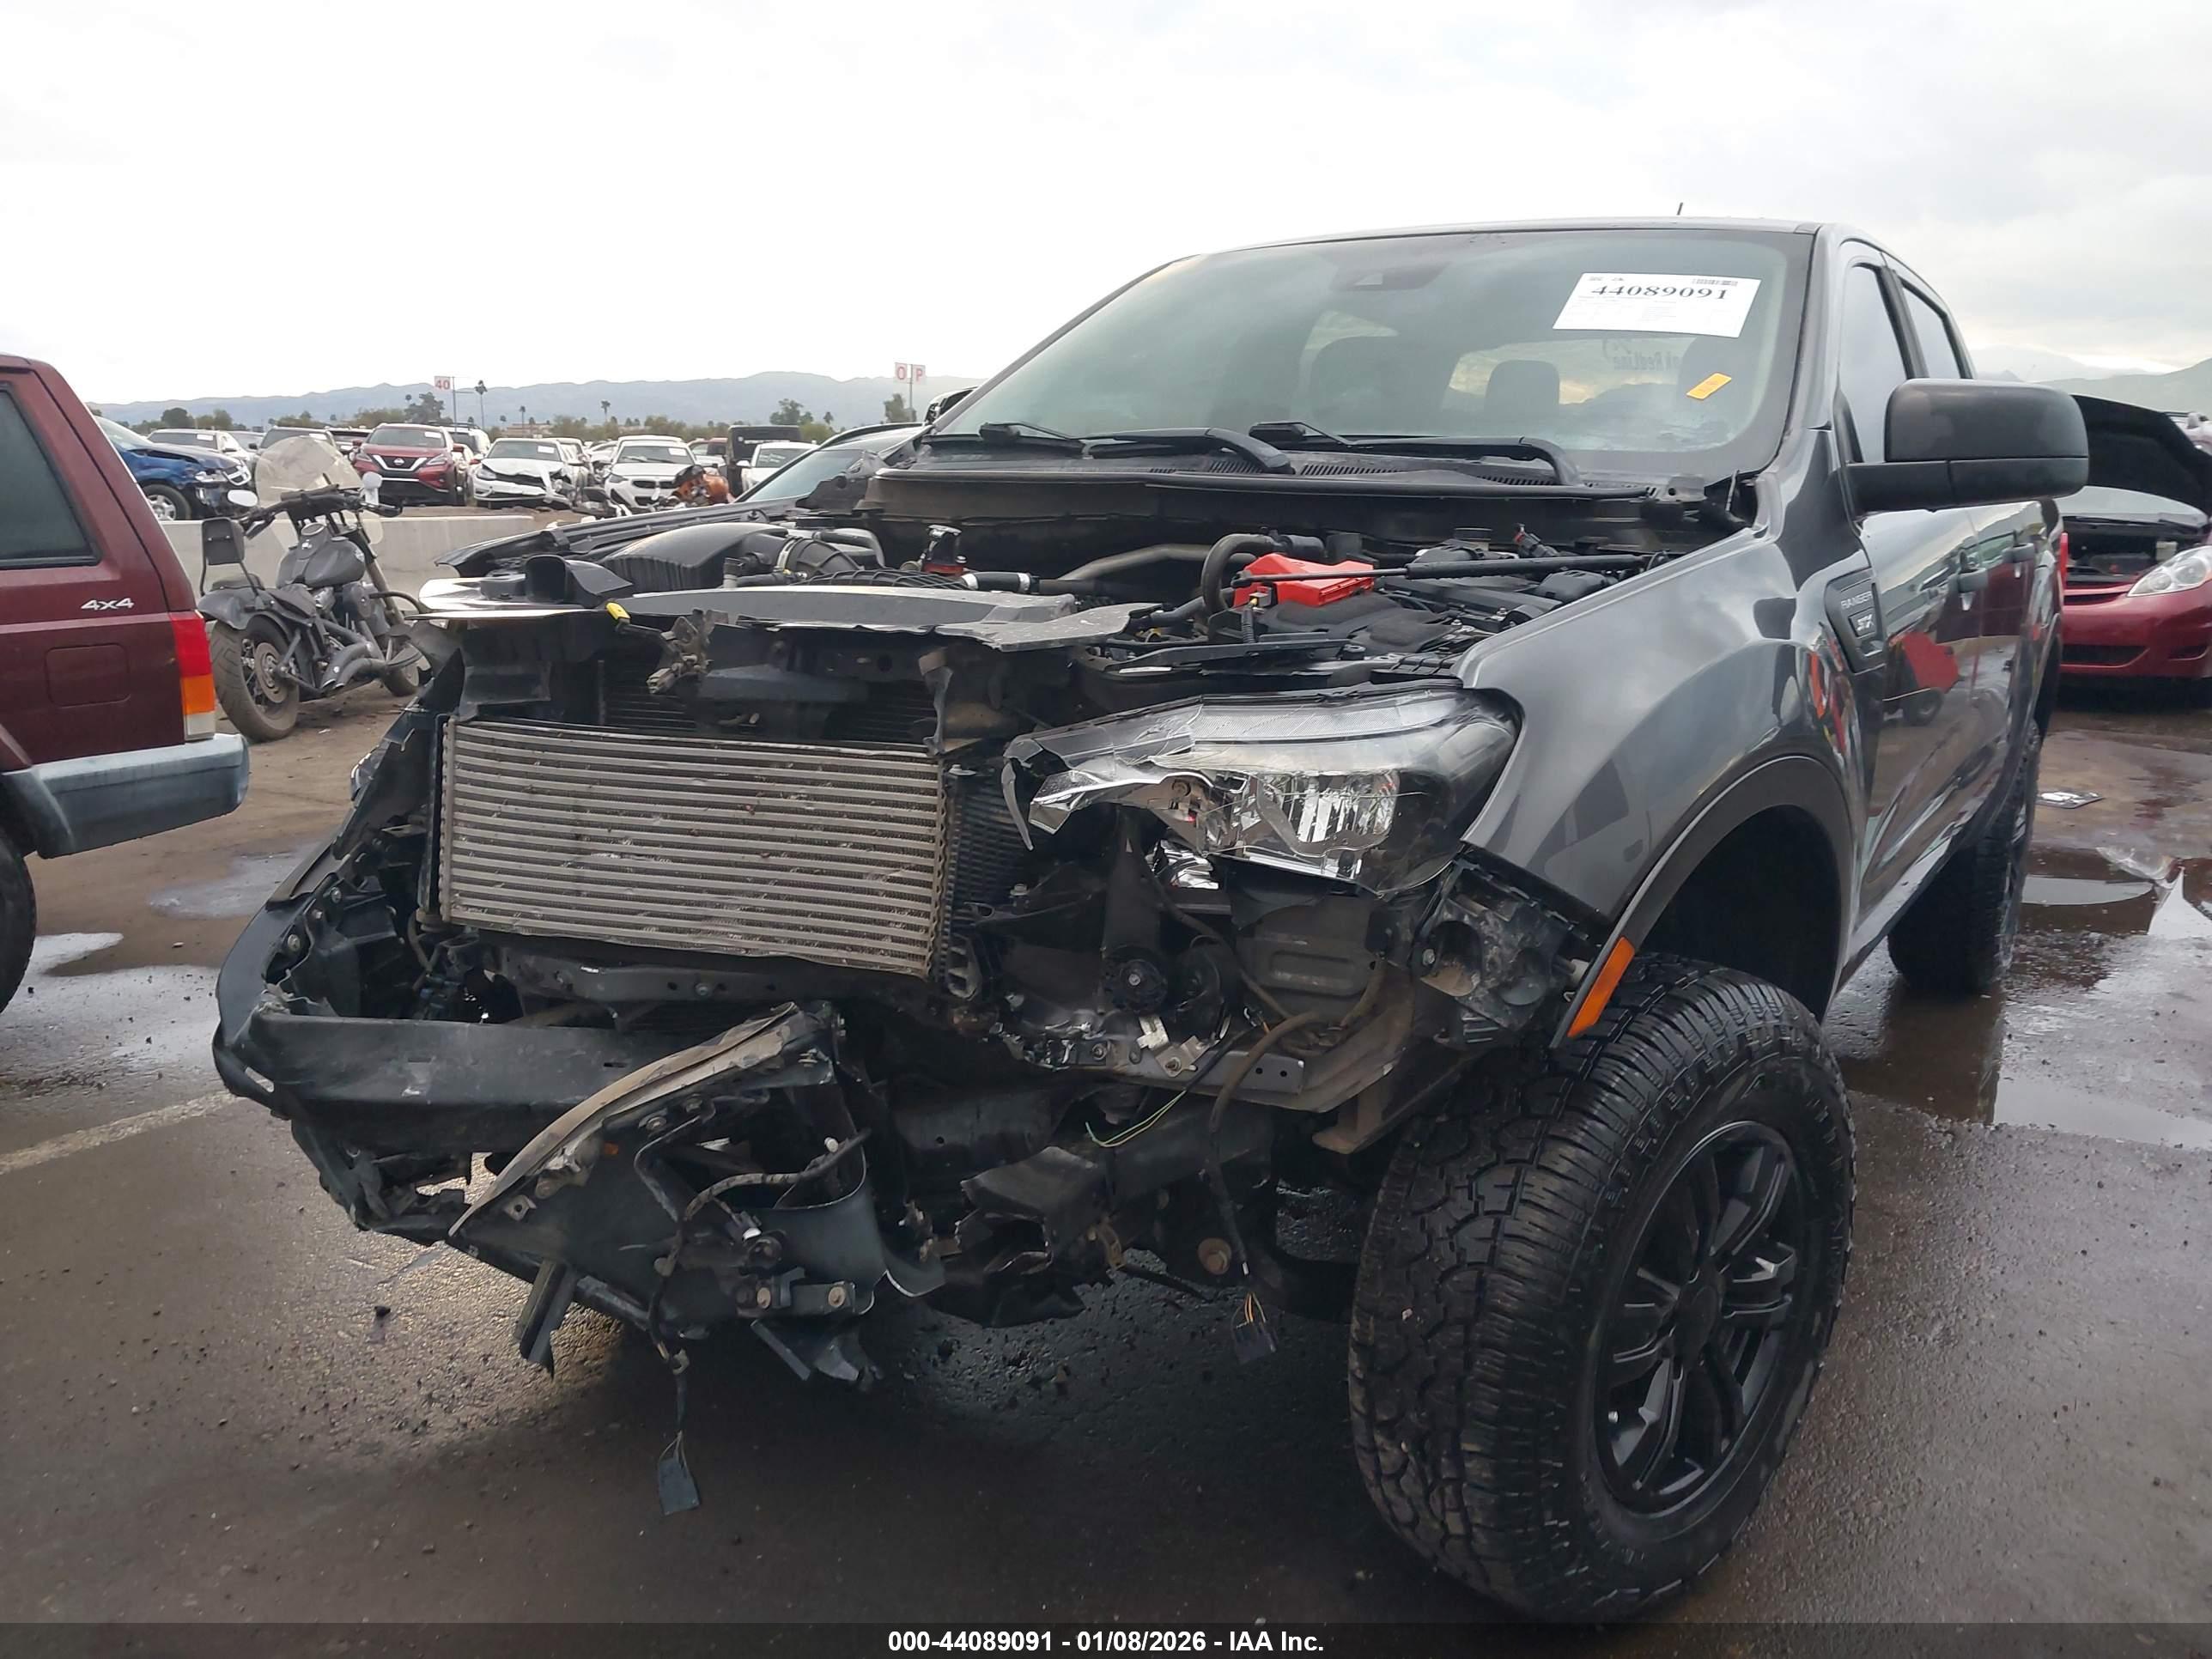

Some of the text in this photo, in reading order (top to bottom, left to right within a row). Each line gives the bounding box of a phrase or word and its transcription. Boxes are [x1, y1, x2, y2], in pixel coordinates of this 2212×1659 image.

[1591, 284, 1729, 300] 44089091
[915, 367, 923, 382] P
[434, 379, 451, 391] 40
